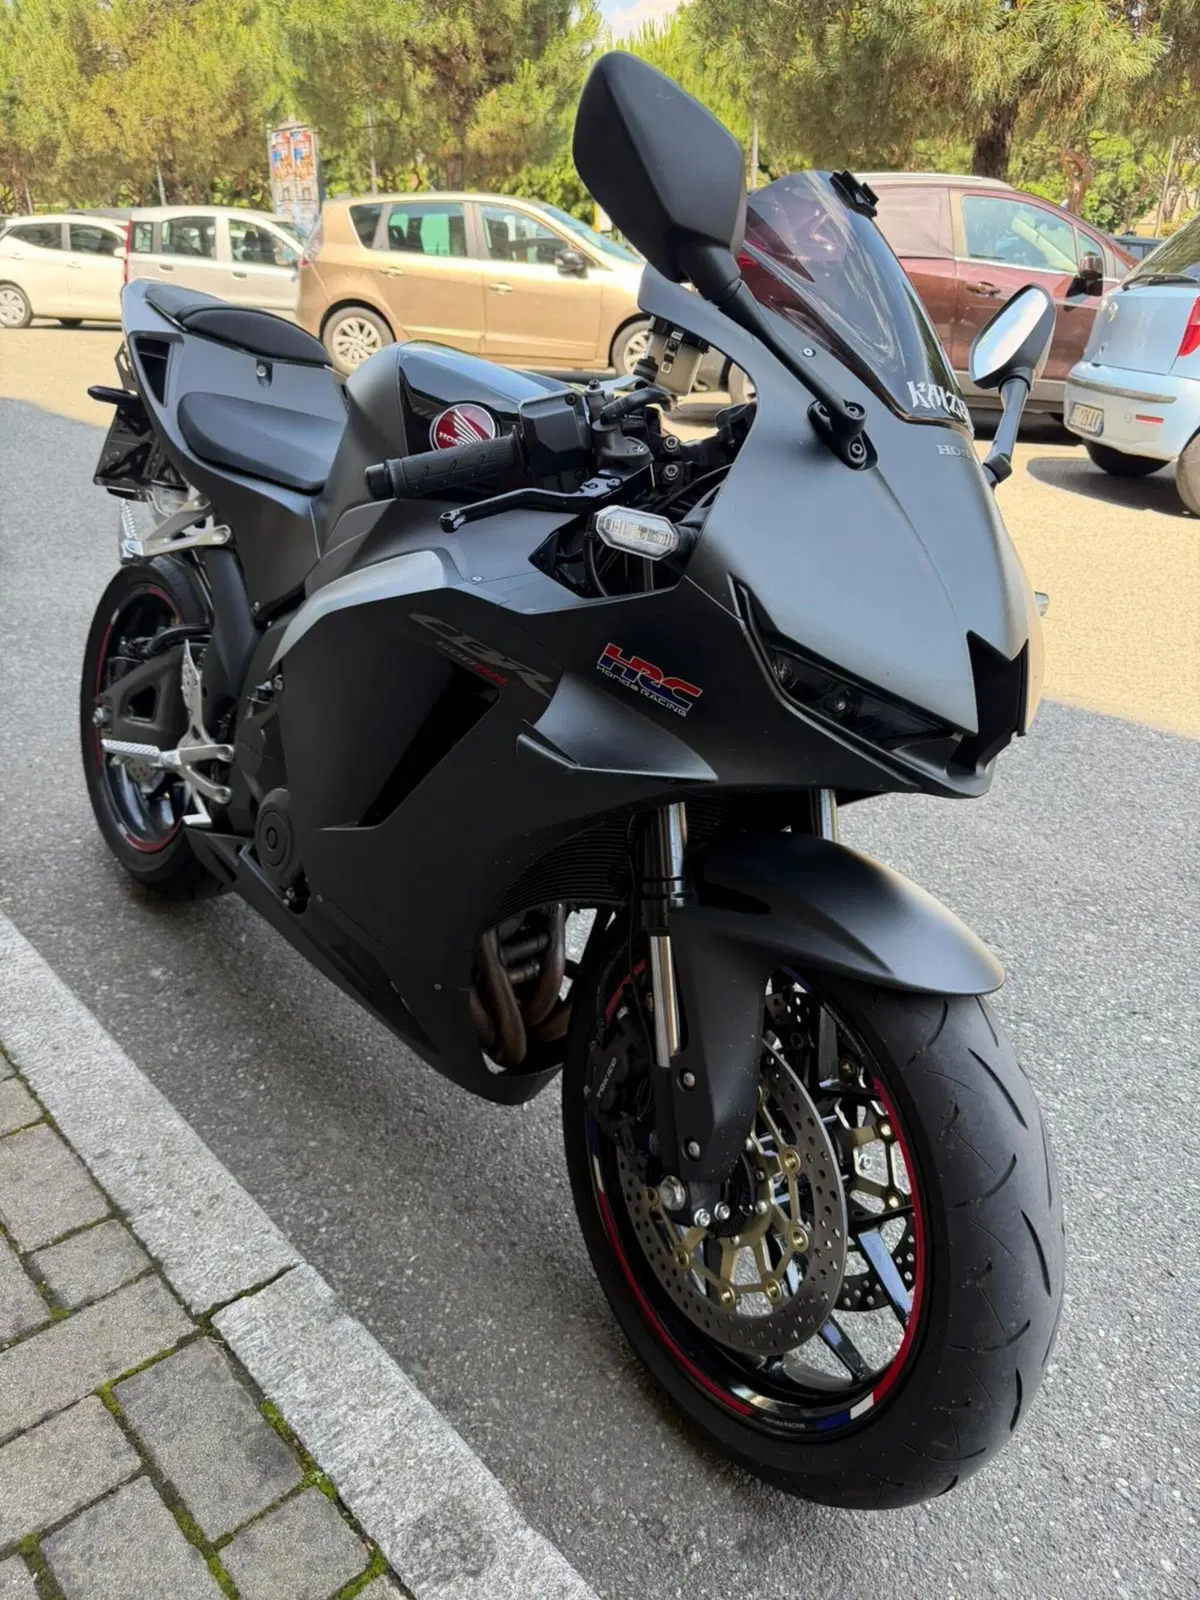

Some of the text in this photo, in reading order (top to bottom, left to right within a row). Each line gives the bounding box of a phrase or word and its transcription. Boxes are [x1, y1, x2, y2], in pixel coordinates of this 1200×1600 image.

[408, 612, 555, 699] CBR
[598, 643, 703, 711] HRC
[596, 664, 687, 717] Honda RACING
